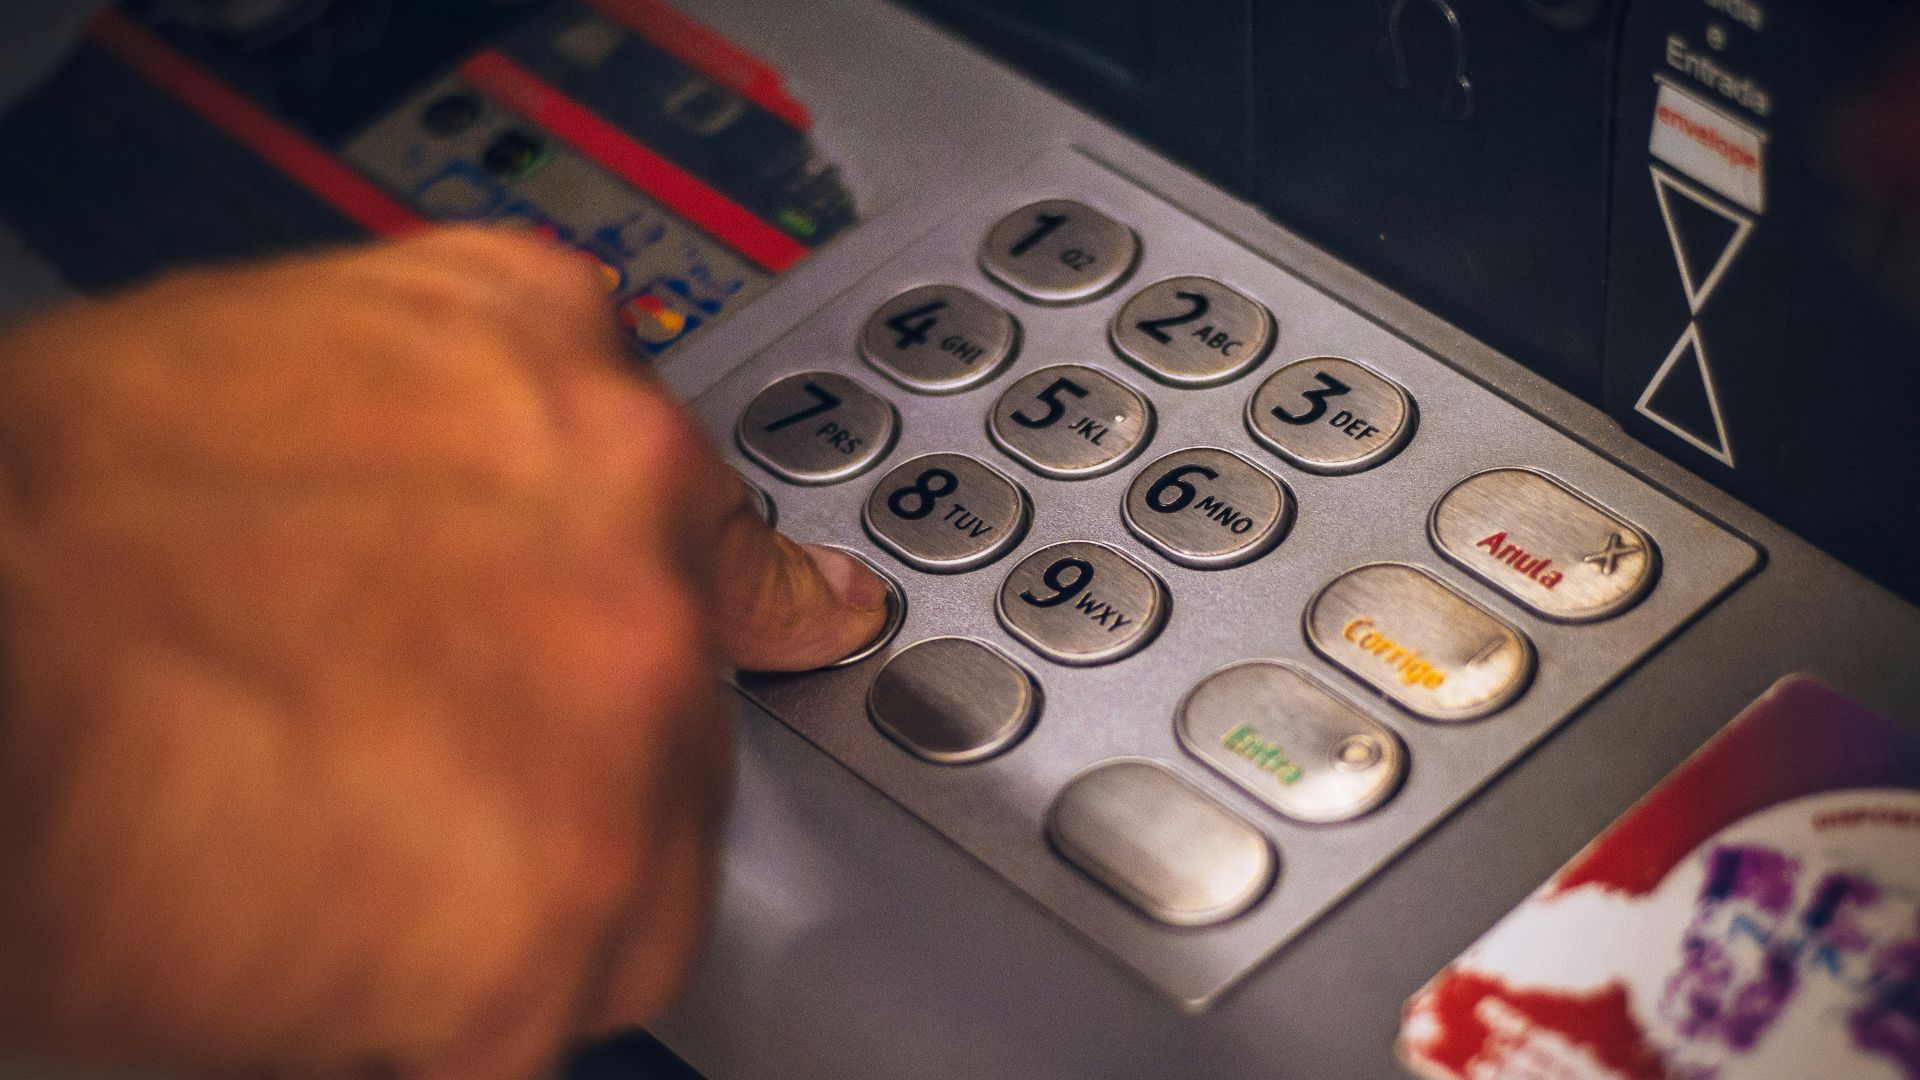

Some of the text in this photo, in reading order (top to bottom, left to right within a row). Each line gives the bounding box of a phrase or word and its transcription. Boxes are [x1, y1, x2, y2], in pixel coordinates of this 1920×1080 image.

[1705, 24, 1727, 51] e
[1666, 35, 1770, 117] Entrada
[1656, 105, 1757, 170] envelope
[1009, 214, 1069, 257] 1
[887, 301, 984, 365] 4 GHI
[1136, 292, 1241, 357] 2 ABC
[764, 382, 863, 454] 7 PRS
[1009, 376, 1108, 447] 5 JKL
[1270, 371, 1380, 442] 3 DEF
[887, 467, 993, 539] 8 TUV
[1145, 463, 1254, 536] 6 MNO
[1018, 556, 1133, 633] 9 WXY
[1476, 531, 1563, 591] Anula
[1343, 618, 1445, 690] Corrige
[1223, 722, 1303, 785] Entra
